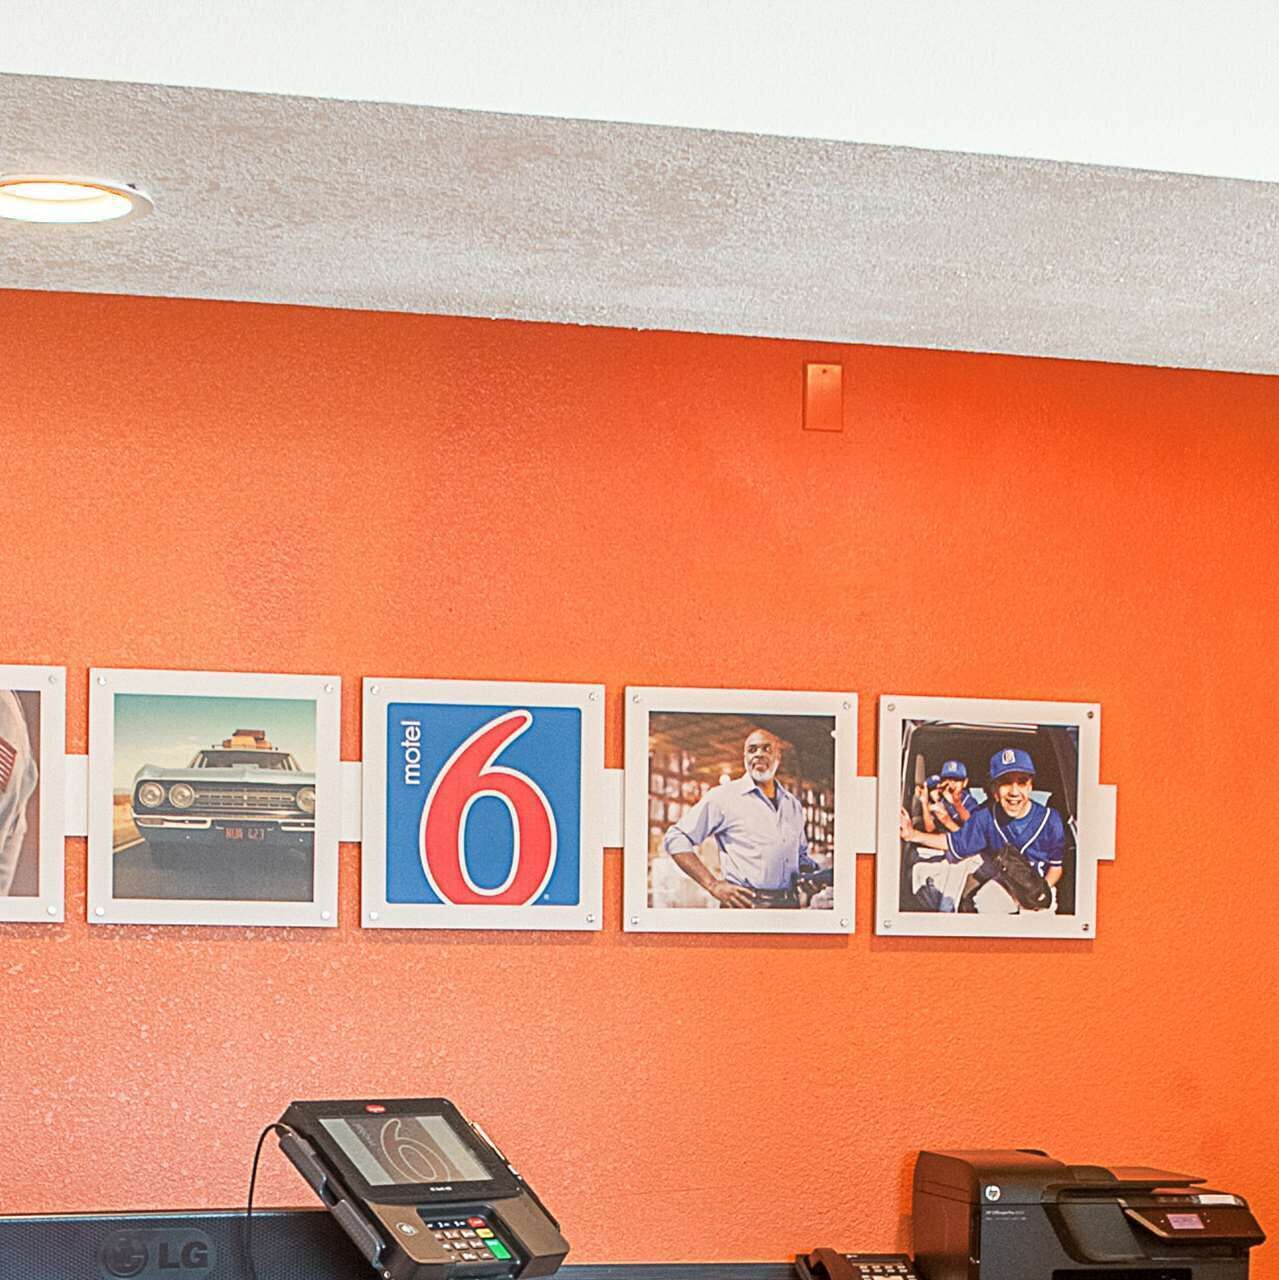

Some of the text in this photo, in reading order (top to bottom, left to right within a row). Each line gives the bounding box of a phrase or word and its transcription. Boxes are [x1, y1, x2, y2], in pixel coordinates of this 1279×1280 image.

[400, 709, 558, 906] motel 6
[159, 1241, 209, 1269] LG
